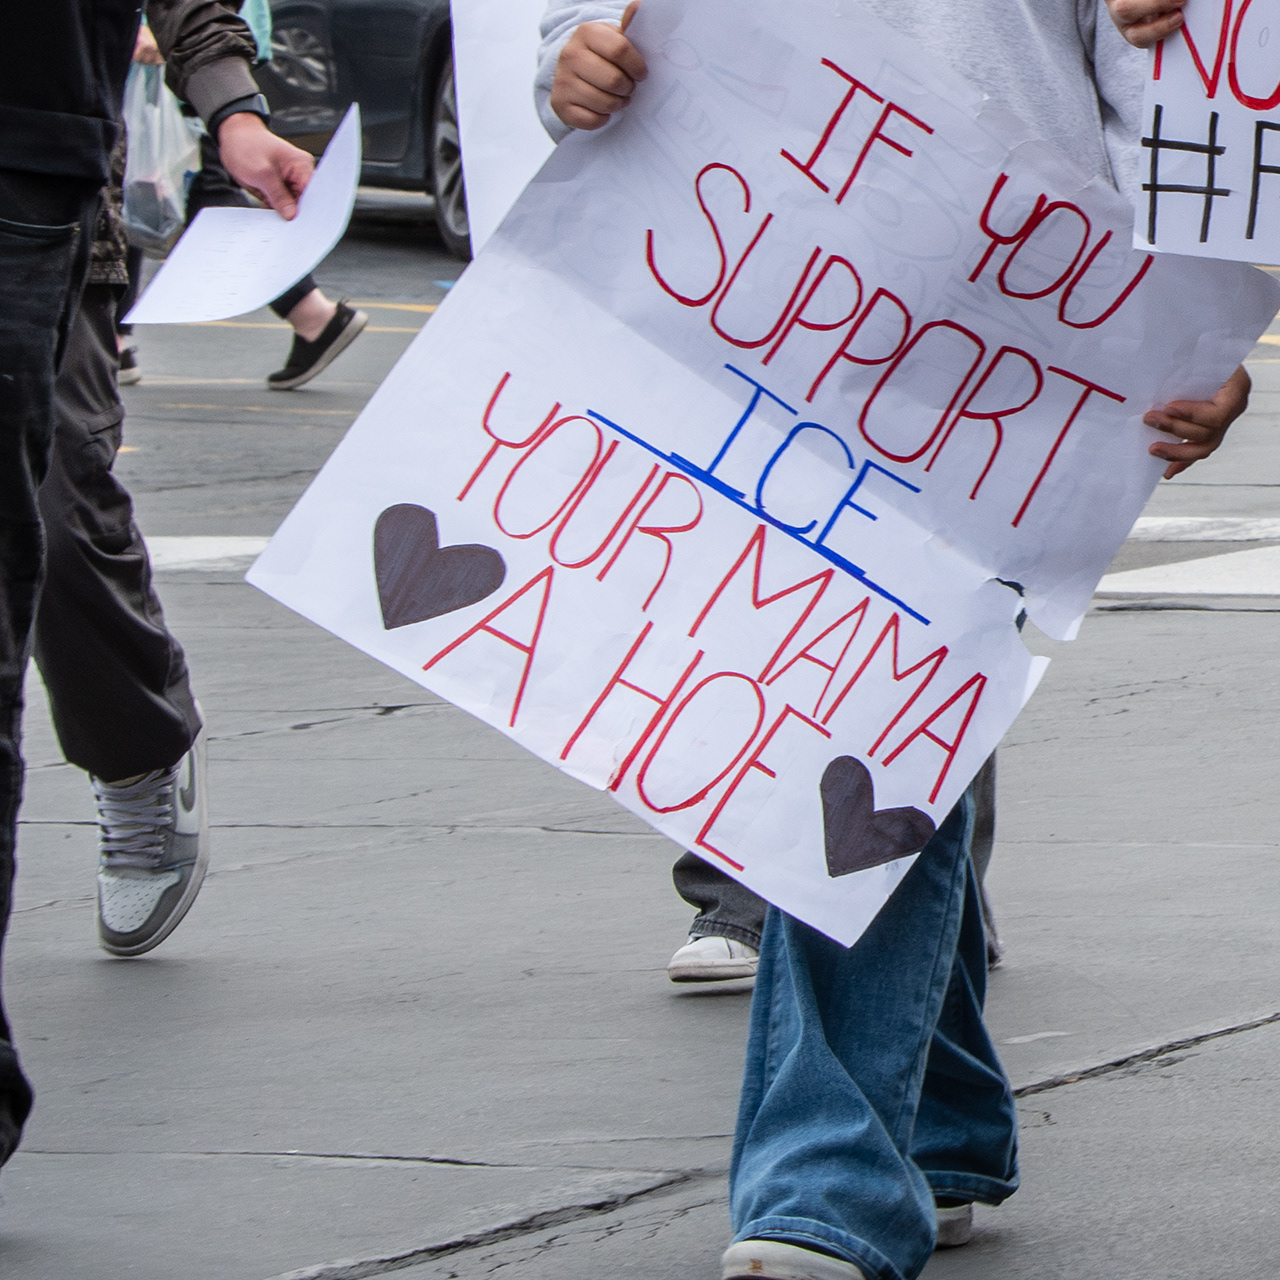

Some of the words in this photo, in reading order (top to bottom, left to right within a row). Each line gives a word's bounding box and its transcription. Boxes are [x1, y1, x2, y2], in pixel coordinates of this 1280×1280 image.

[643, 162, 1127, 528] SUPPORT
[776, 57, 935, 206] IF
[966, 172, 1155, 330] YOU
[457, 371, 703, 612] YOUR
[686, 523, 988, 805] MAMA
[668, 362, 922, 578] ICE
[422, 564, 557, 730] A
[558, 620, 834, 872] HOE
